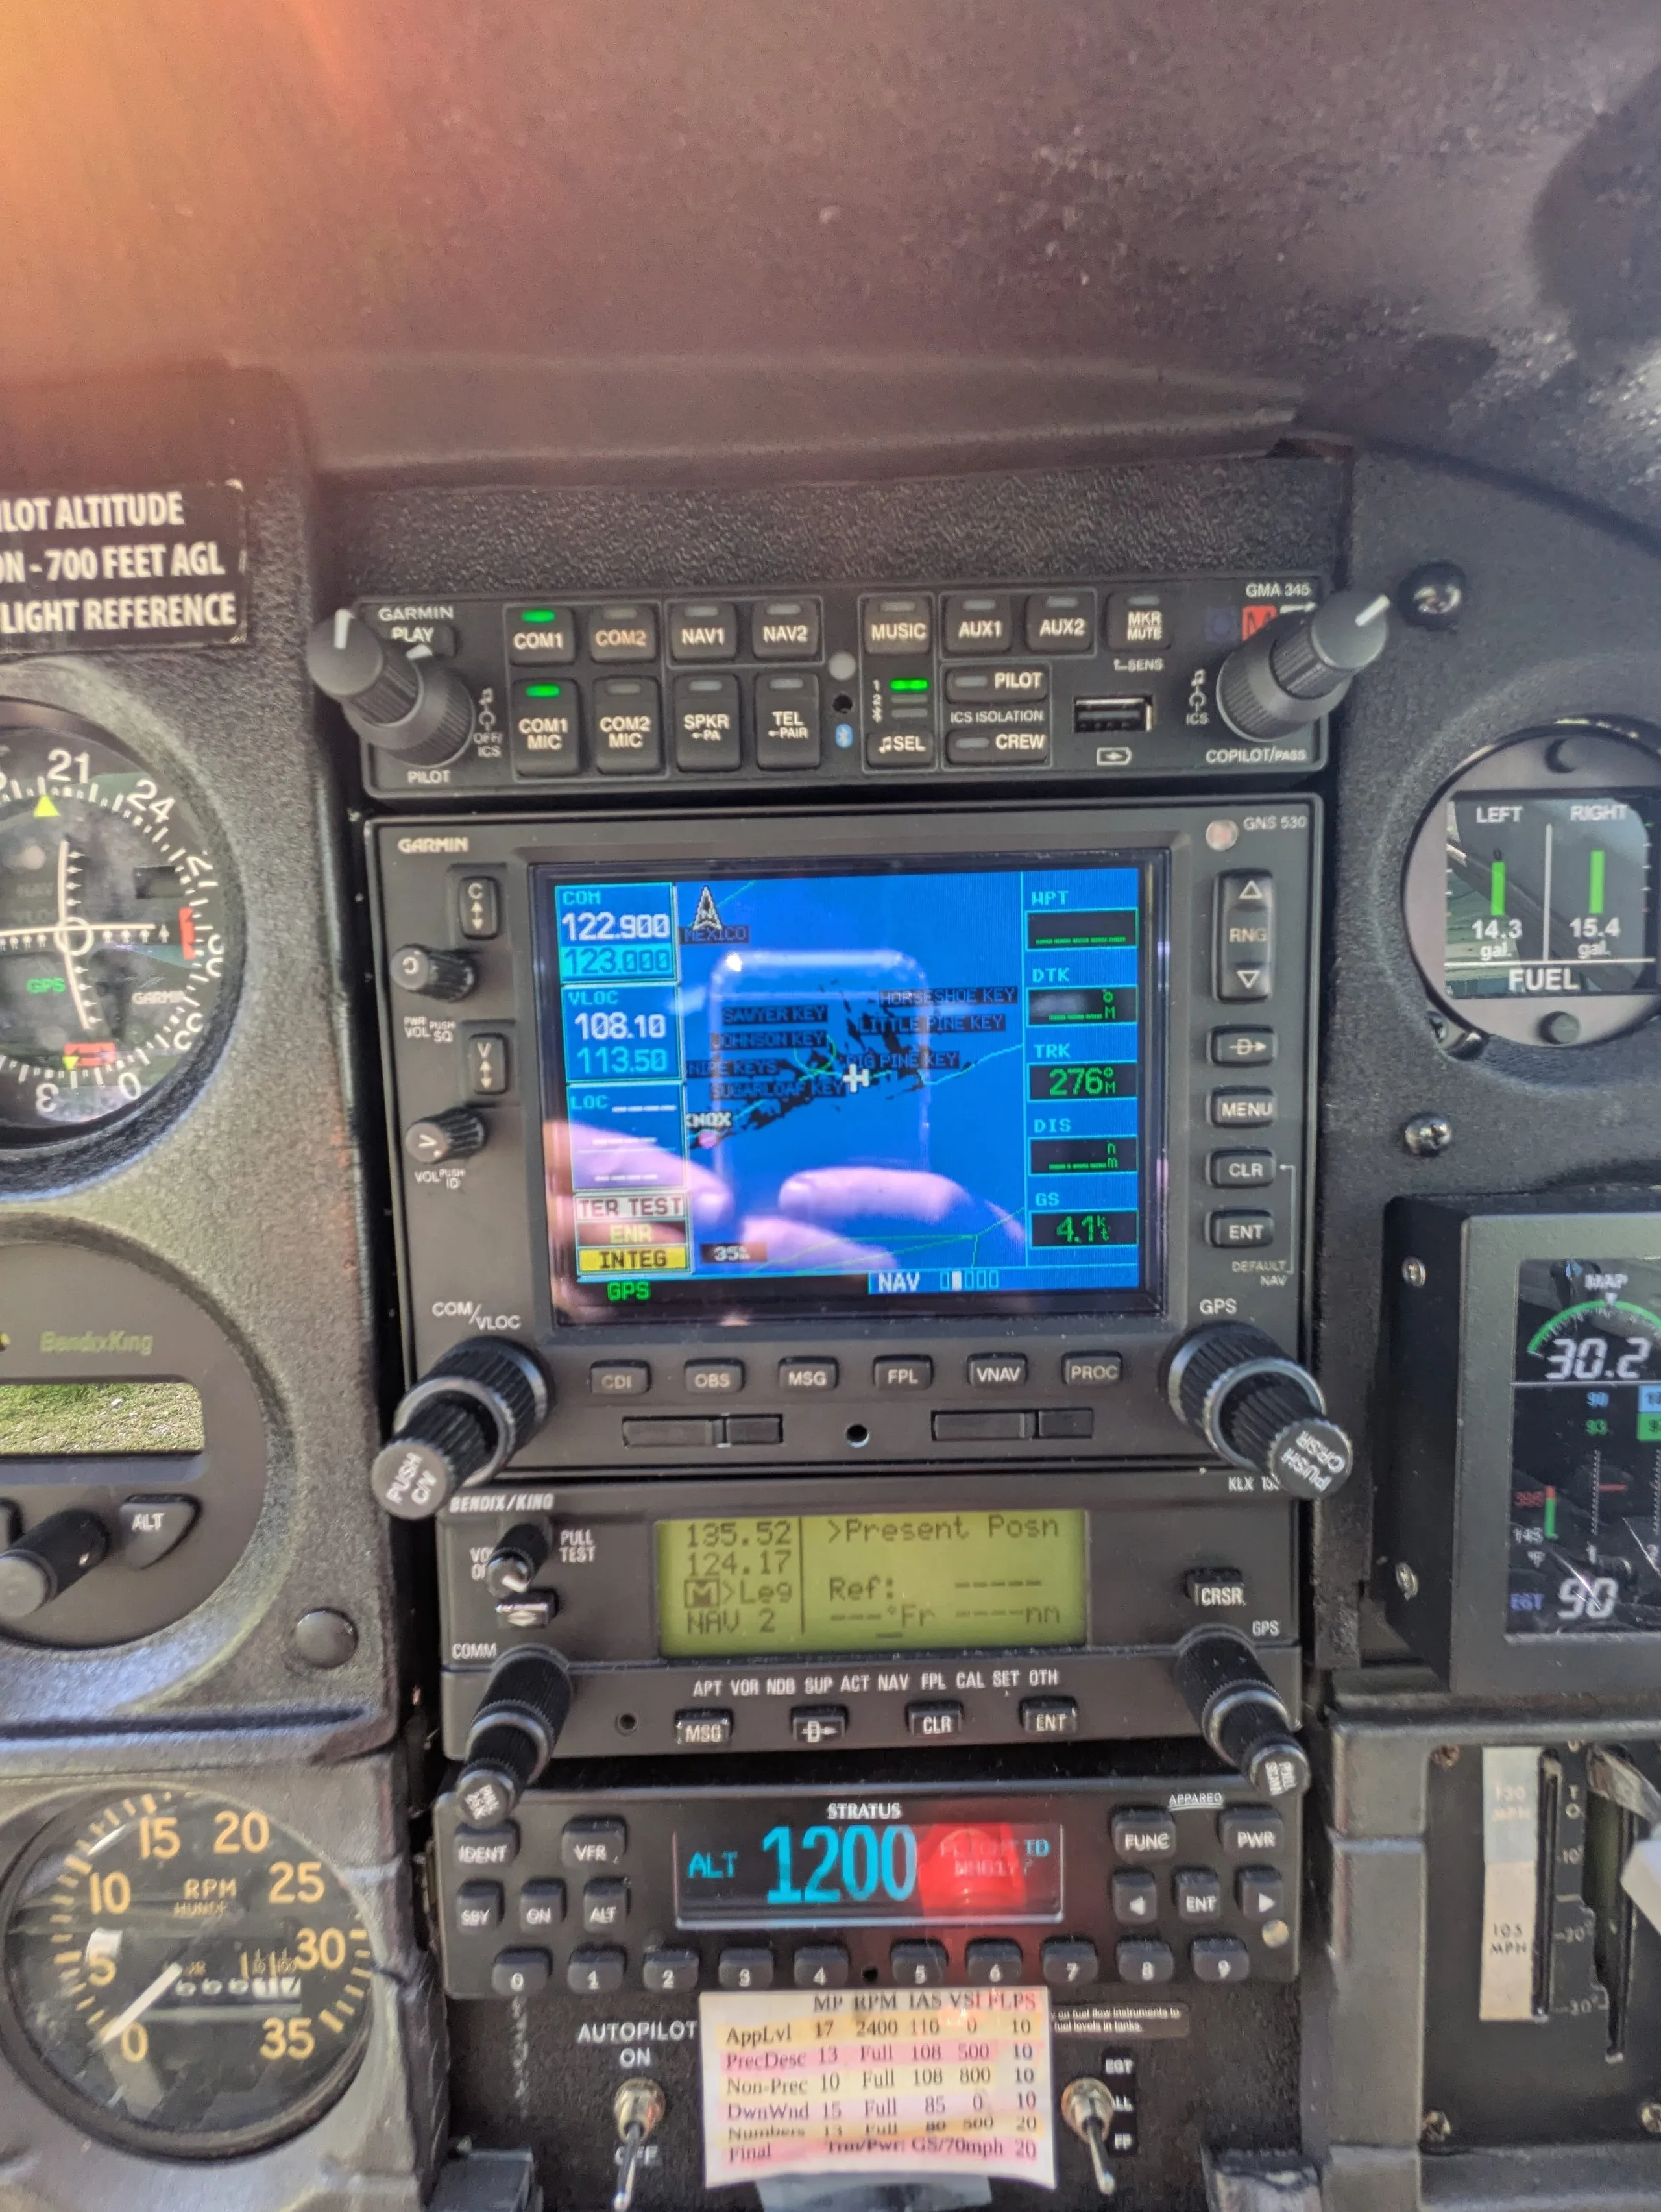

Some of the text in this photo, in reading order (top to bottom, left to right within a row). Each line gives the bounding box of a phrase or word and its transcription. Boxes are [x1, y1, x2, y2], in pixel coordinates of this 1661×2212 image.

[55, 491, 185, 530] ALTITUDE
[44, 548, 98, 581] 700
[101, 544, 166, 579] FEET
[171, 541, 226, 577] AGL
[1246, 582, 1312, 598] GMA 345
[1, 592, 236, 634] LIGHT REFERENCE
[378, 605, 454, 622] GARMIN
[391, 627, 433, 643] PLAY
[681, 627, 725, 646] NAV1
[762, 625, 809, 642] NAV2
[871, 622, 928, 640] MUSIC
[958, 620, 1002, 638] AUX1
[1039, 618, 1085, 637] AUX2
[513, 633, 564, 650] COM1
[595, 630, 647, 648] COM2
[994, 672, 1043, 689] PILOT
[519, 718, 568, 734] COM1
[600, 716, 651, 733] COM2
[683, 714, 730, 730] SPKR
[771, 711, 803, 727] TEL
[951, 710, 1043, 724] ICS ISOLATION
[527, 734, 563, 750] MIC
[608, 733, 643, 748] MIC
[779, 727, 808, 739] PAIR
[995, 734, 1046, 749] CREW
[47, 748, 90, 784] 21
[407, 770, 451, 784] PILOT
[127, 779, 175, 823] 24
[1476, 805, 1523, 824] LEFT
[1570, 804, 1627, 821] RIGHT
[1243, 816, 1307, 831] GNS 530
[397, 837, 469, 854] GARMIN
[562, 890, 601, 906] COM
[561, 911, 671, 942] 122.900
[684, 927, 746, 942] MEXICO
[1229, 927, 1267, 942] RNG
[563, 947, 671, 974] 123.000
[1032, 967, 1070, 982] DTK
[1509, 968, 1581, 991] FUEL
[568, 990, 619, 1006] VLOC
[723, 1005, 825, 1023] SAWYER KEY
[574, 1011, 666, 1041] 108.10
[711, 1031, 823, 1049] JOHNSON KEY
[1034, 1043, 1071, 1058] TRK
[576, 1046, 667, 1074] 113.50
[570, 1095, 607, 1110] LOC
[1222, 1103, 1273, 1117] MENU
[1034, 1118, 1072, 1133] DIS
[1228, 1163, 1263, 1178] CLR
[577, 1197, 681, 1217] TER TEST
[610, 1225, 651, 1244] ENR
[1228, 1225, 1264, 1240] ENT
[599, 1250, 667, 1269] INTEG
[1231, 1260, 1287, 1273] DEFAULT
[1199, 1299, 1237, 1315] GPS
[1545, 1337, 1651, 1381] 30.2
[694, 1373, 731, 1388] OBS
[788, 1371, 827, 1387] MSG
[888, 1370, 918, 1384] FPL
[977, 1367, 1021, 1382] VNAV
[1071, 1365, 1118, 1379] PROC
[450, 1493, 554, 1513] BENDIX/KING
[688, 1521, 791, 1548] 135.52
[989, 1514, 1059, 1538] Posn
[561, 1529, 594, 1546] PULL
[559, 1546, 596, 1563] TEST
[688, 1550, 791, 1577] 124.17
[1201, 1587, 1243, 1606] CRSR
[1557, 1577, 1619, 1620] 90
[1252, 1621, 1279, 1636] GPS
[452, 1643, 497, 1659] COMM
[692, 1669, 1059, 1697] APT VOR NDB SUP ACT NAV FPL CAL SET OTH
[923, 1716, 951, 1734] CLR
[1036, 1714, 1067, 1731] ENT
[1169, 1793, 1223, 1806] APPAREO
[827, 1802, 903, 1820] STRATUS
[139, 1817, 182, 1860] 15
[213, 1810, 270, 1854] 20
[1237, 1830, 1276, 1848] PWR
[1125, 1833, 1170, 1851] FUNC
[458, 1845, 507, 1864] IDENT
[762, 1823, 917, 1905] 1200
[183, 1878, 237, 1899] RPM
[268, 1861, 325, 1904] 25
[90, 1871, 130, 1914] 10
[1186, 1895, 1217, 1912] ENT
[527, 1908, 551, 1925] ON
[590, 1907, 616, 1924] ALT
[295, 1928, 346, 1971] 30
[814, 1991, 1036, 2011] MP RPM IAS VSI FLPS
[260, 2017, 315, 2060] 35
[577, 2020, 697, 2043] AUTOPILOT
[727, 2017, 1030, 2049] AppLvl 17 2400 110 0 10
[620, 2047, 651, 2069] ON
[727, 2043, 1032, 2071] PrecDesc 13 Full 108 500 10
[727, 2066, 1034, 2095] Non-Prec 10 Full 108 800 10
[727, 2091, 1036, 2121] DwnWnd 15 Full 85 0 10
[728, 2126, 805, 2141] Numbers
[866, 2121, 897, 2136] Full
[1015, 2115, 1037, 2131] 20
